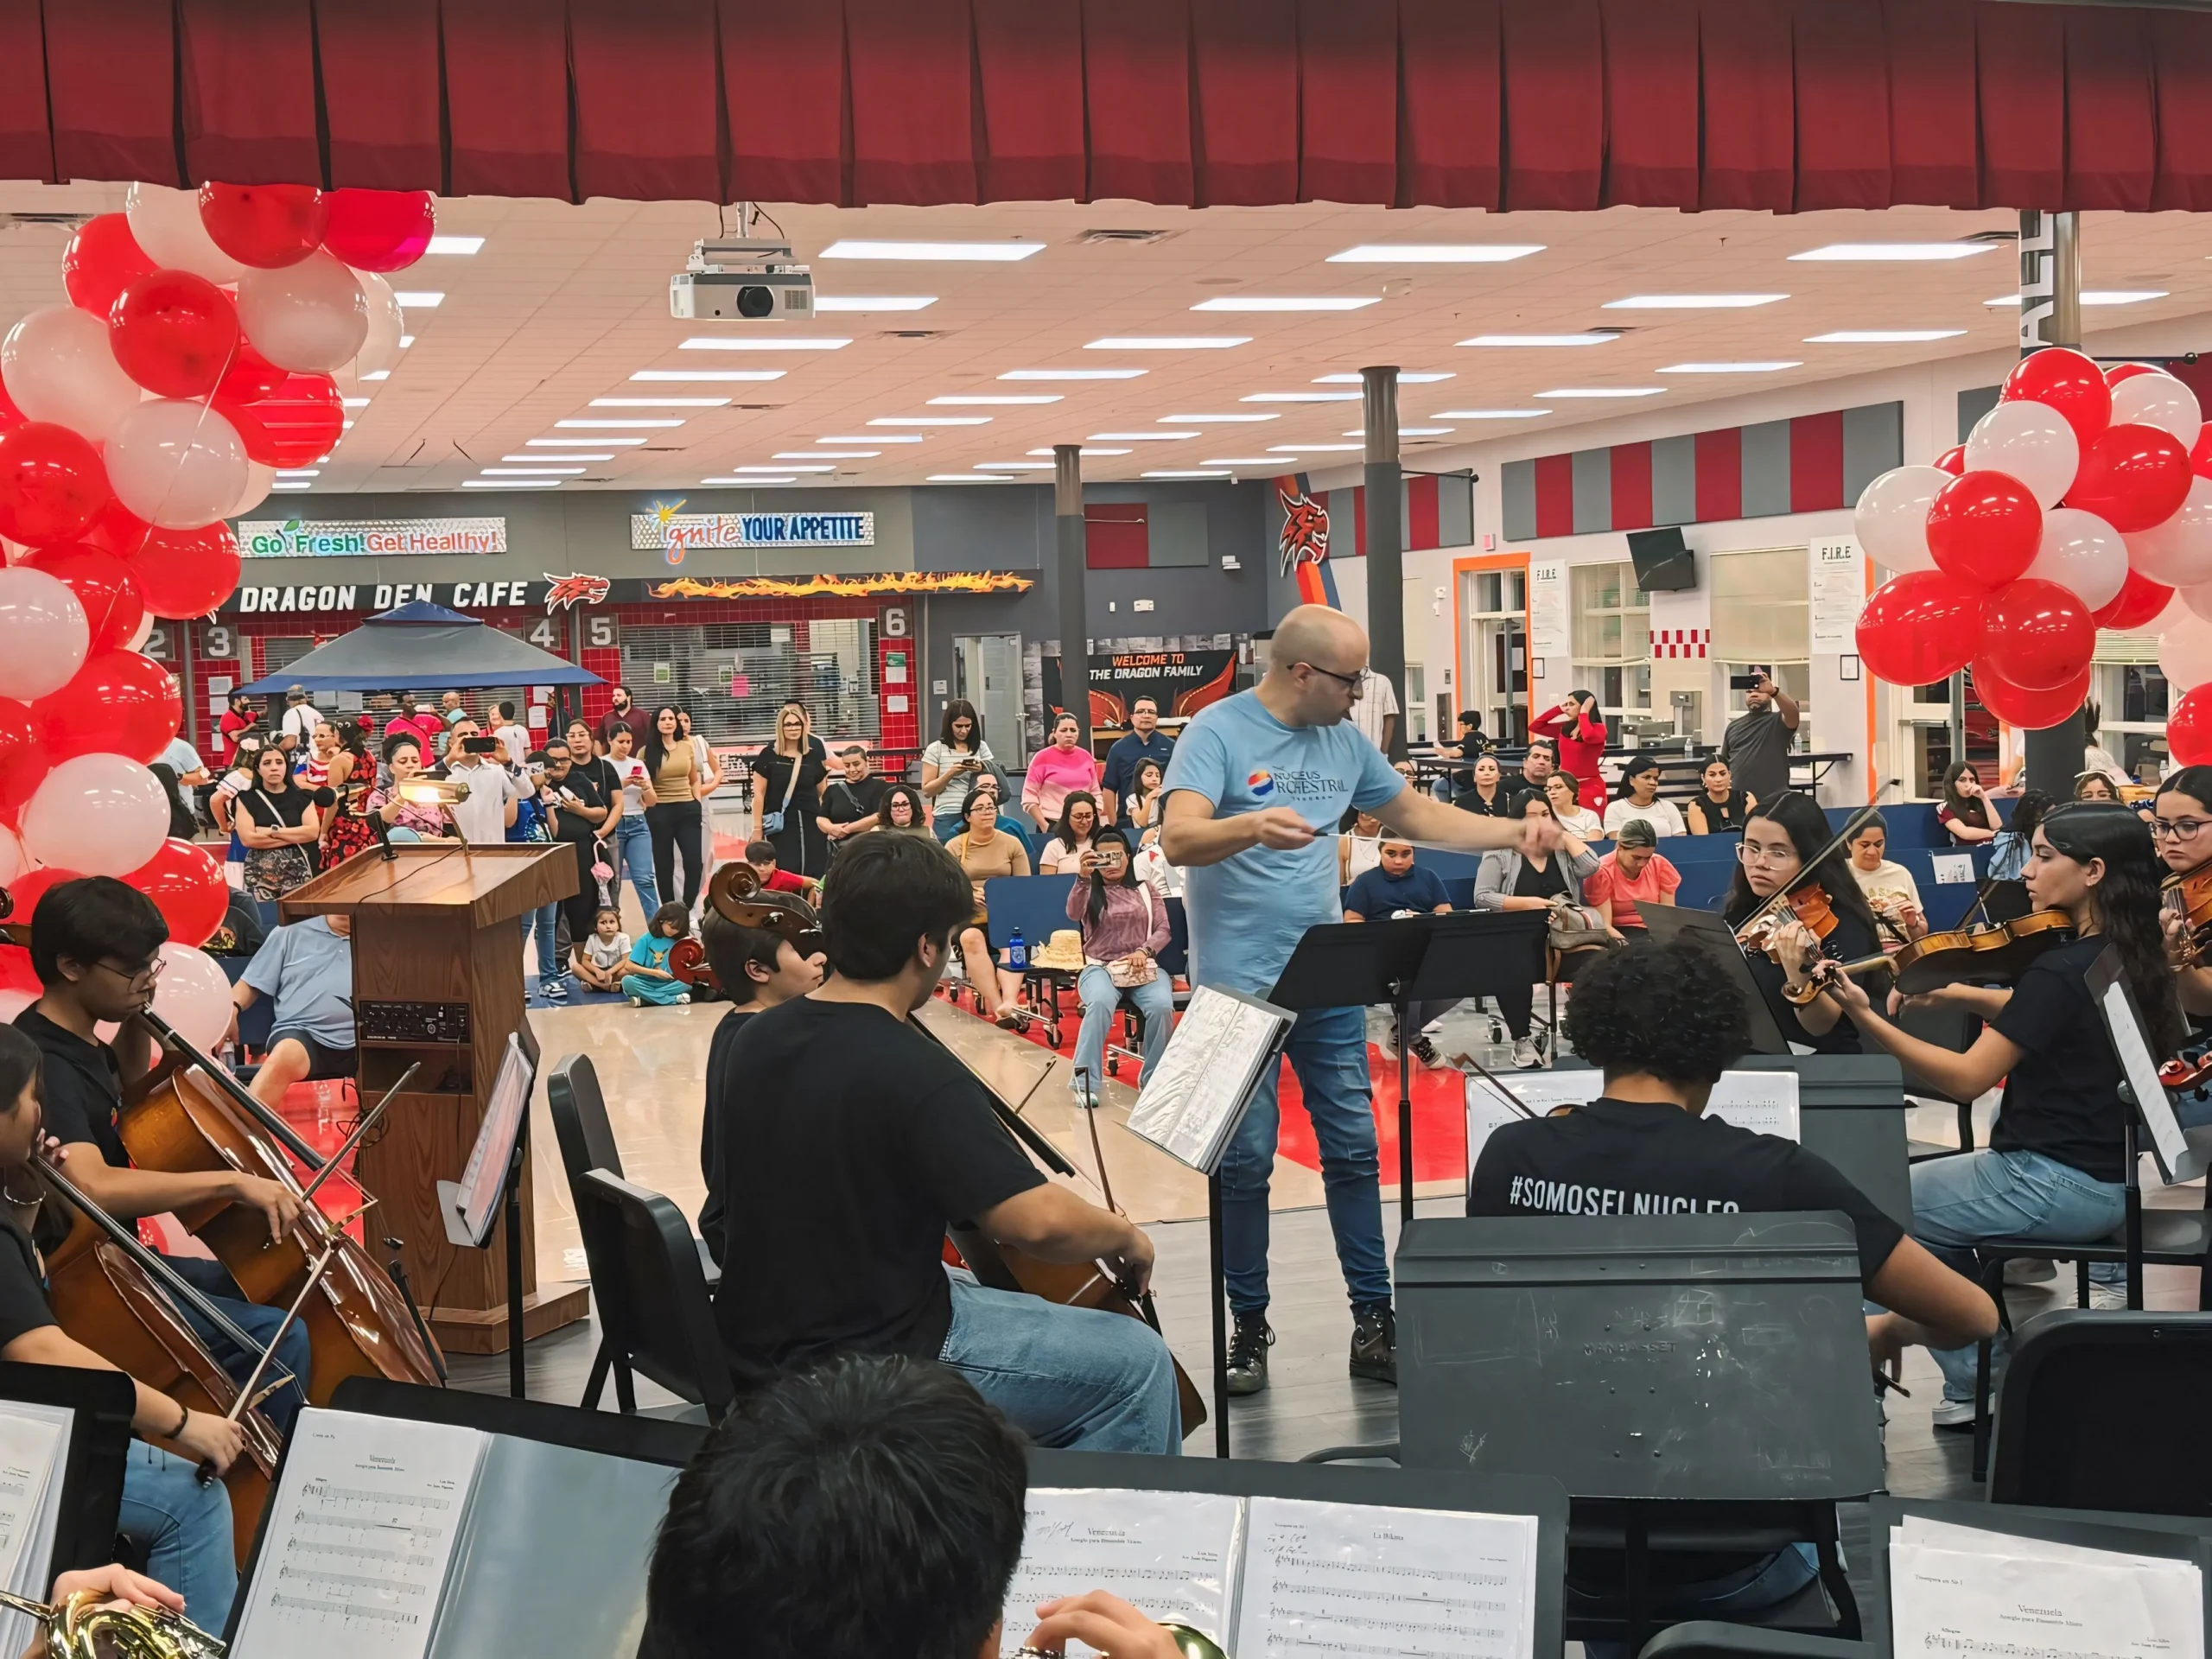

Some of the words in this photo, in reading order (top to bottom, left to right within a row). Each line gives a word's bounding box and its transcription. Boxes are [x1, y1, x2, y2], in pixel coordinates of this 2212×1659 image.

[251, 534, 283, 554] Go
[296, 533, 365, 553] Fresh!
[366, 533, 406, 551] Get
[410, 531, 498, 554] Healthy!
[742, 517, 786, 541] YOUR
[790, 516, 864, 539] APPETITE
[239, 585, 356, 613] DRAGON
[373, 582, 433, 609] DEN
[453, 582, 528, 607] CAFE
[530, 618, 555, 647] 4
[591, 617, 612, 645] 5
[886, 607, 906, 636] 6
[143, 628, 167, 658] 2
[207, 626, 230, 657] 3
[1089, 669, 1111, 680] THE
[1114, 666, 1160, 679] DRAGON
[1164, 665, 1203, 677] FAMILY
[1112, 654, 1167, 666] WELCOME
[1171, 653, 1184, 664] TO
[2018, 1604, 2063, 1617] Venezuela
